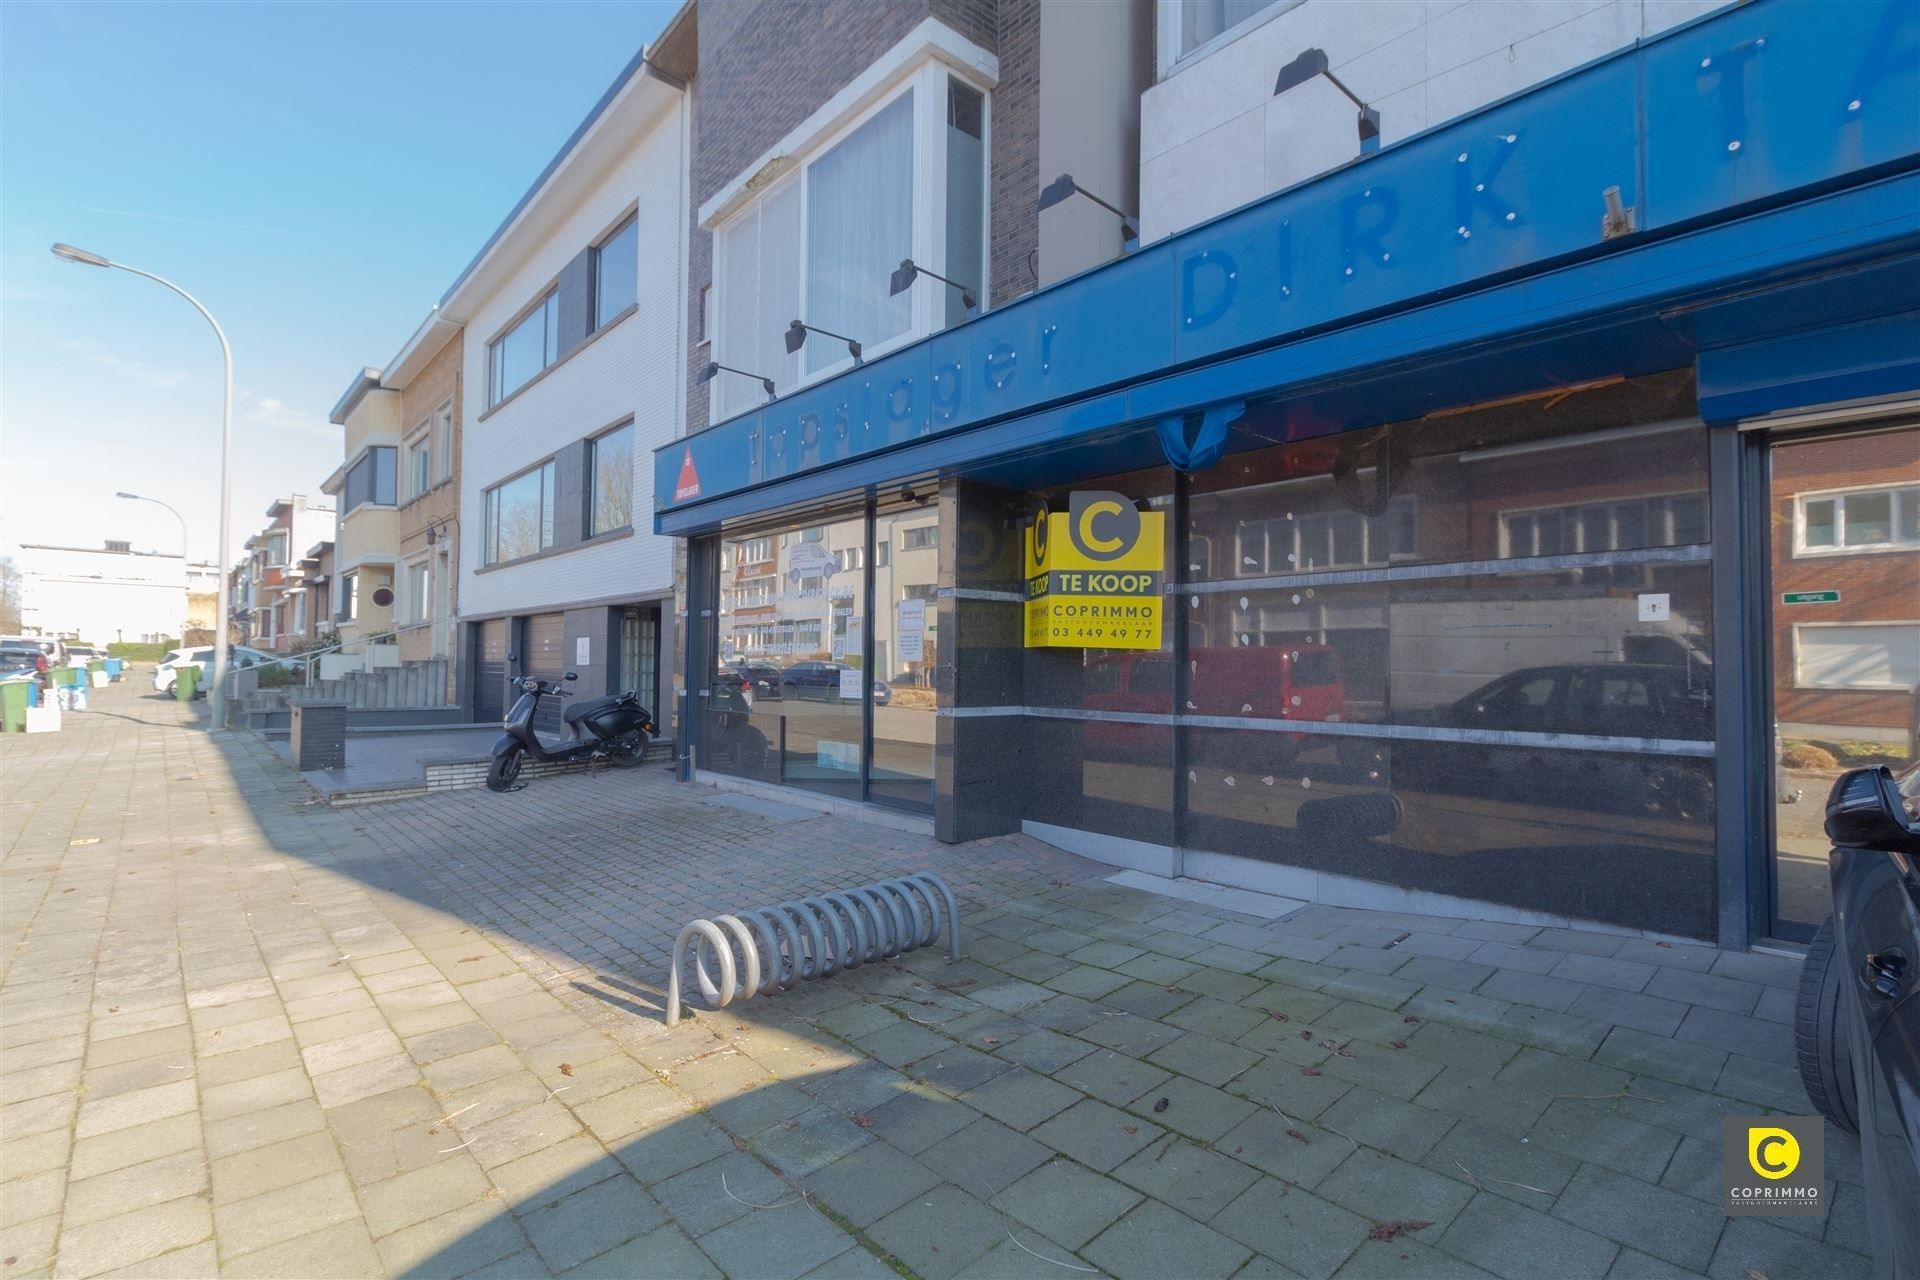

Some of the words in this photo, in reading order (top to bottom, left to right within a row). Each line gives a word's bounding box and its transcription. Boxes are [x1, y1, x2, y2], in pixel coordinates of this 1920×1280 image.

[1182, 128, 1526, 333] DIRK
[1079, 501, 1124, 552] C
[1059, 574, 1082, 592] TE
[1088, 574, 1153, 593] KOOP
[1053, 605, 1153, 618] COPRIMMO
[1052, 627, 1070, 637] 03
[1077, 627, 1103, 637] 449
[1110, 629, 1127, 638] 49
[1135, 629, 1152, 639] 77
